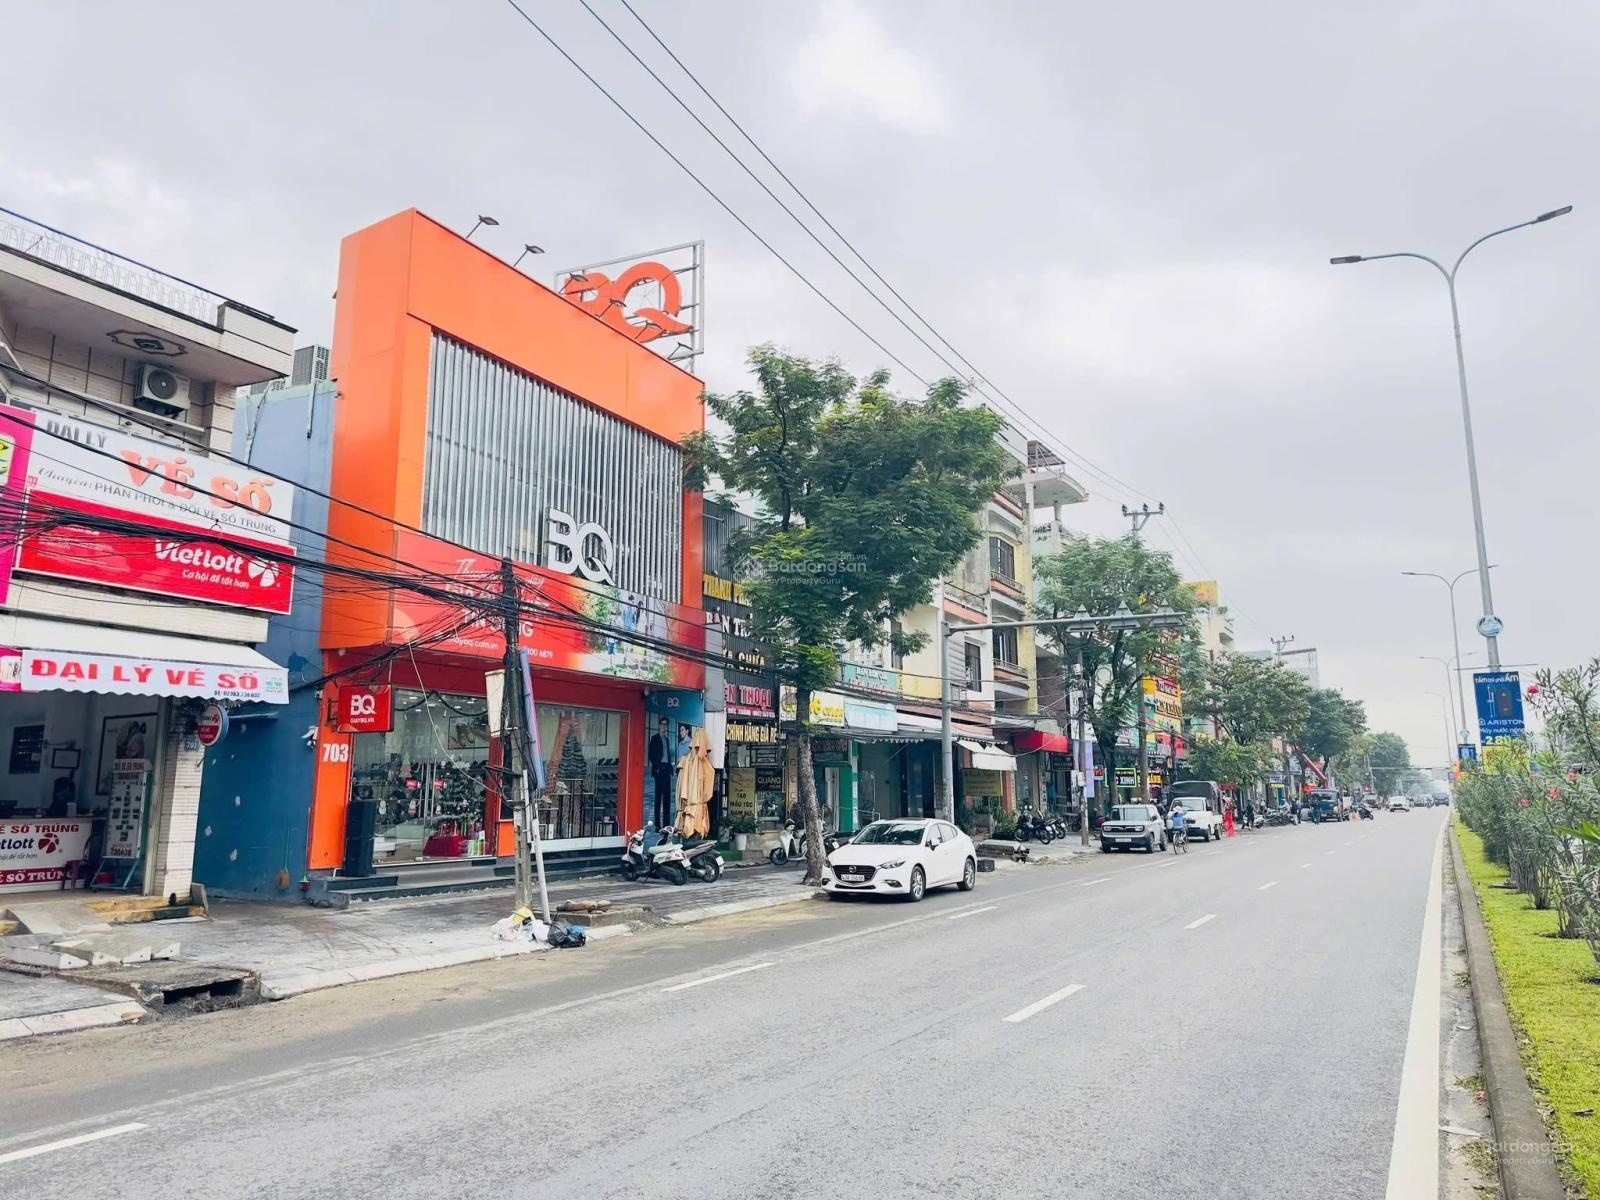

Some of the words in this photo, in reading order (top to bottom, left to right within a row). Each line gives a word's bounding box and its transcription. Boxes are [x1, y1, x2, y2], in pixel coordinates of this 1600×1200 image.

[208, 475, 274, 518] SỐ
[155, 538, 243, 573] Vietlott
[546, 508, 617, 587] BQ
[197, 571, 209, 582] hội
[221, 574, 232, 585] tốt
[30, 659, 97, 683] ĐẠI
[112, 664, 152, 684] LÝ
[165, 668, 205, 687] VÉ
[217, 670, 258, 689] SỐ
[351, 695, 376, 716] BQ
[667, 697, 680, 707] BQ
[323, 744, 349, 762] 703
[7, 870, 25, 882] SỐ
